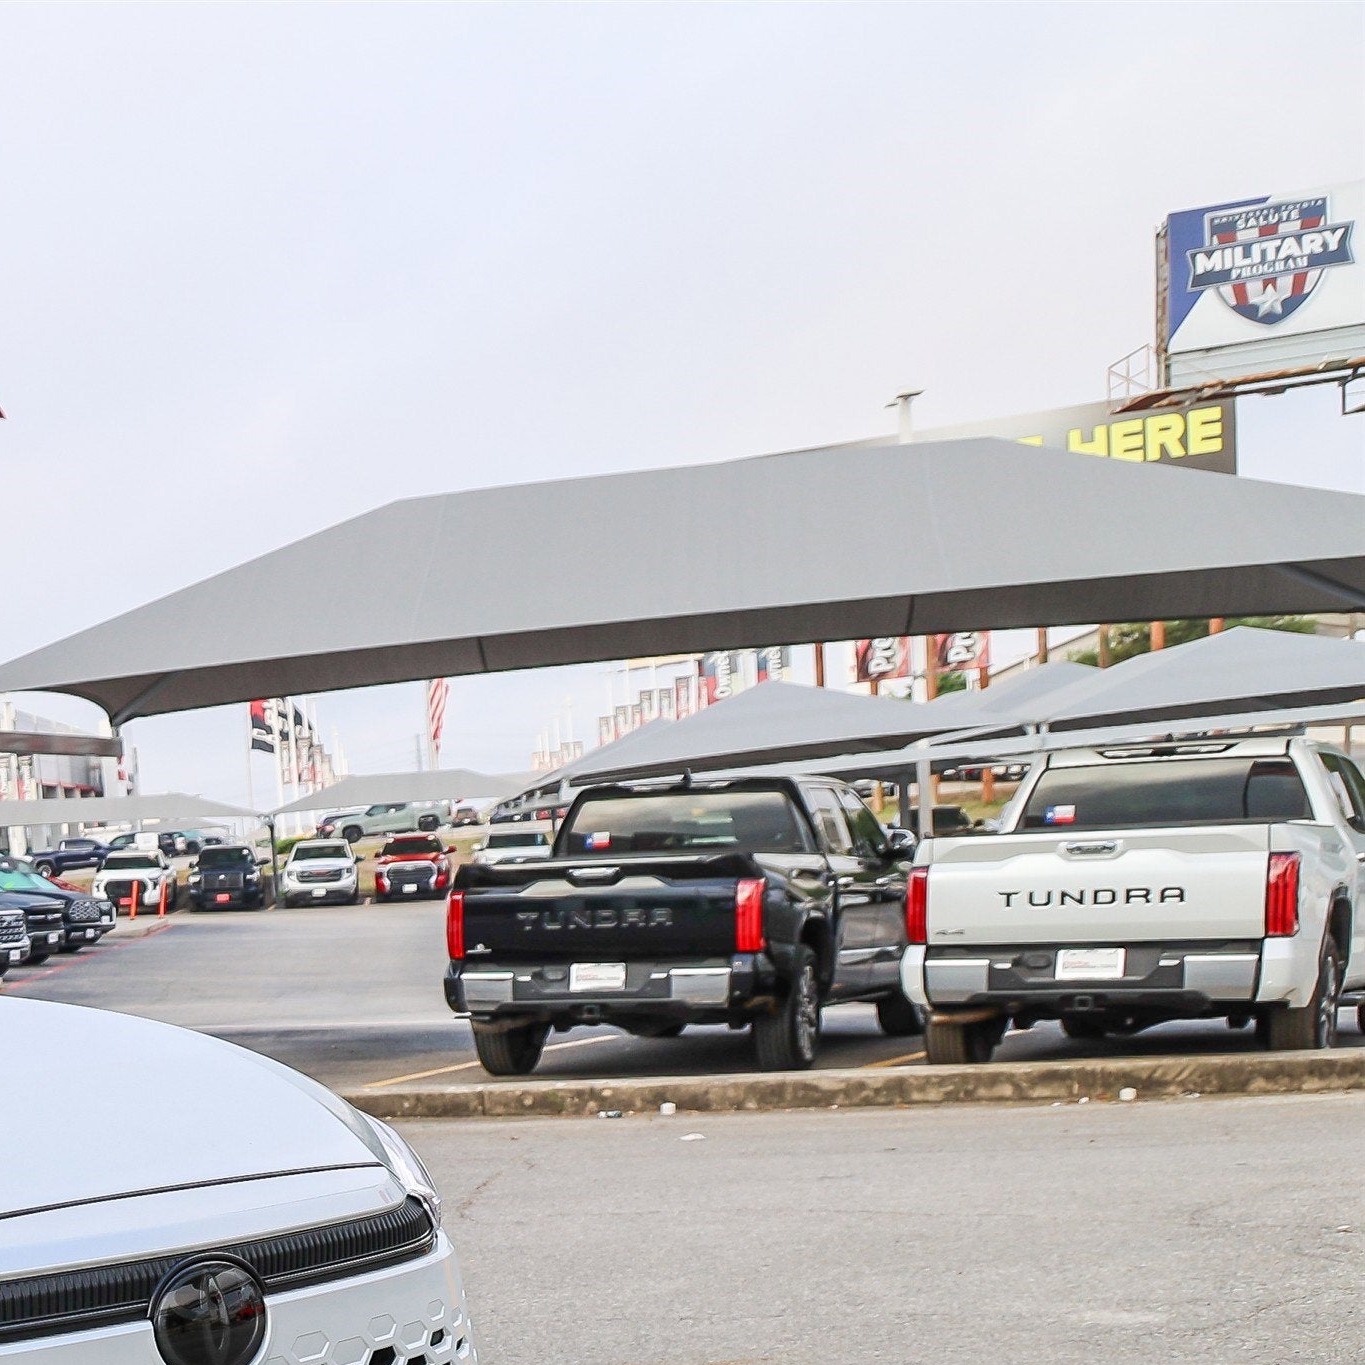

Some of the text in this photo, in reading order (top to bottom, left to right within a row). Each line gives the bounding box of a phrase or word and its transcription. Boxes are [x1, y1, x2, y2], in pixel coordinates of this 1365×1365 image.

[1236, 208, 1300, 230] SALUTE
[1195, 226, 1347, 275] MILITARY
[1230, 255, 1309, 280] PROGRAM
[997, 885, 1188, 911] TUNDRA
[516, 907, 674, 931] TUNDRA
